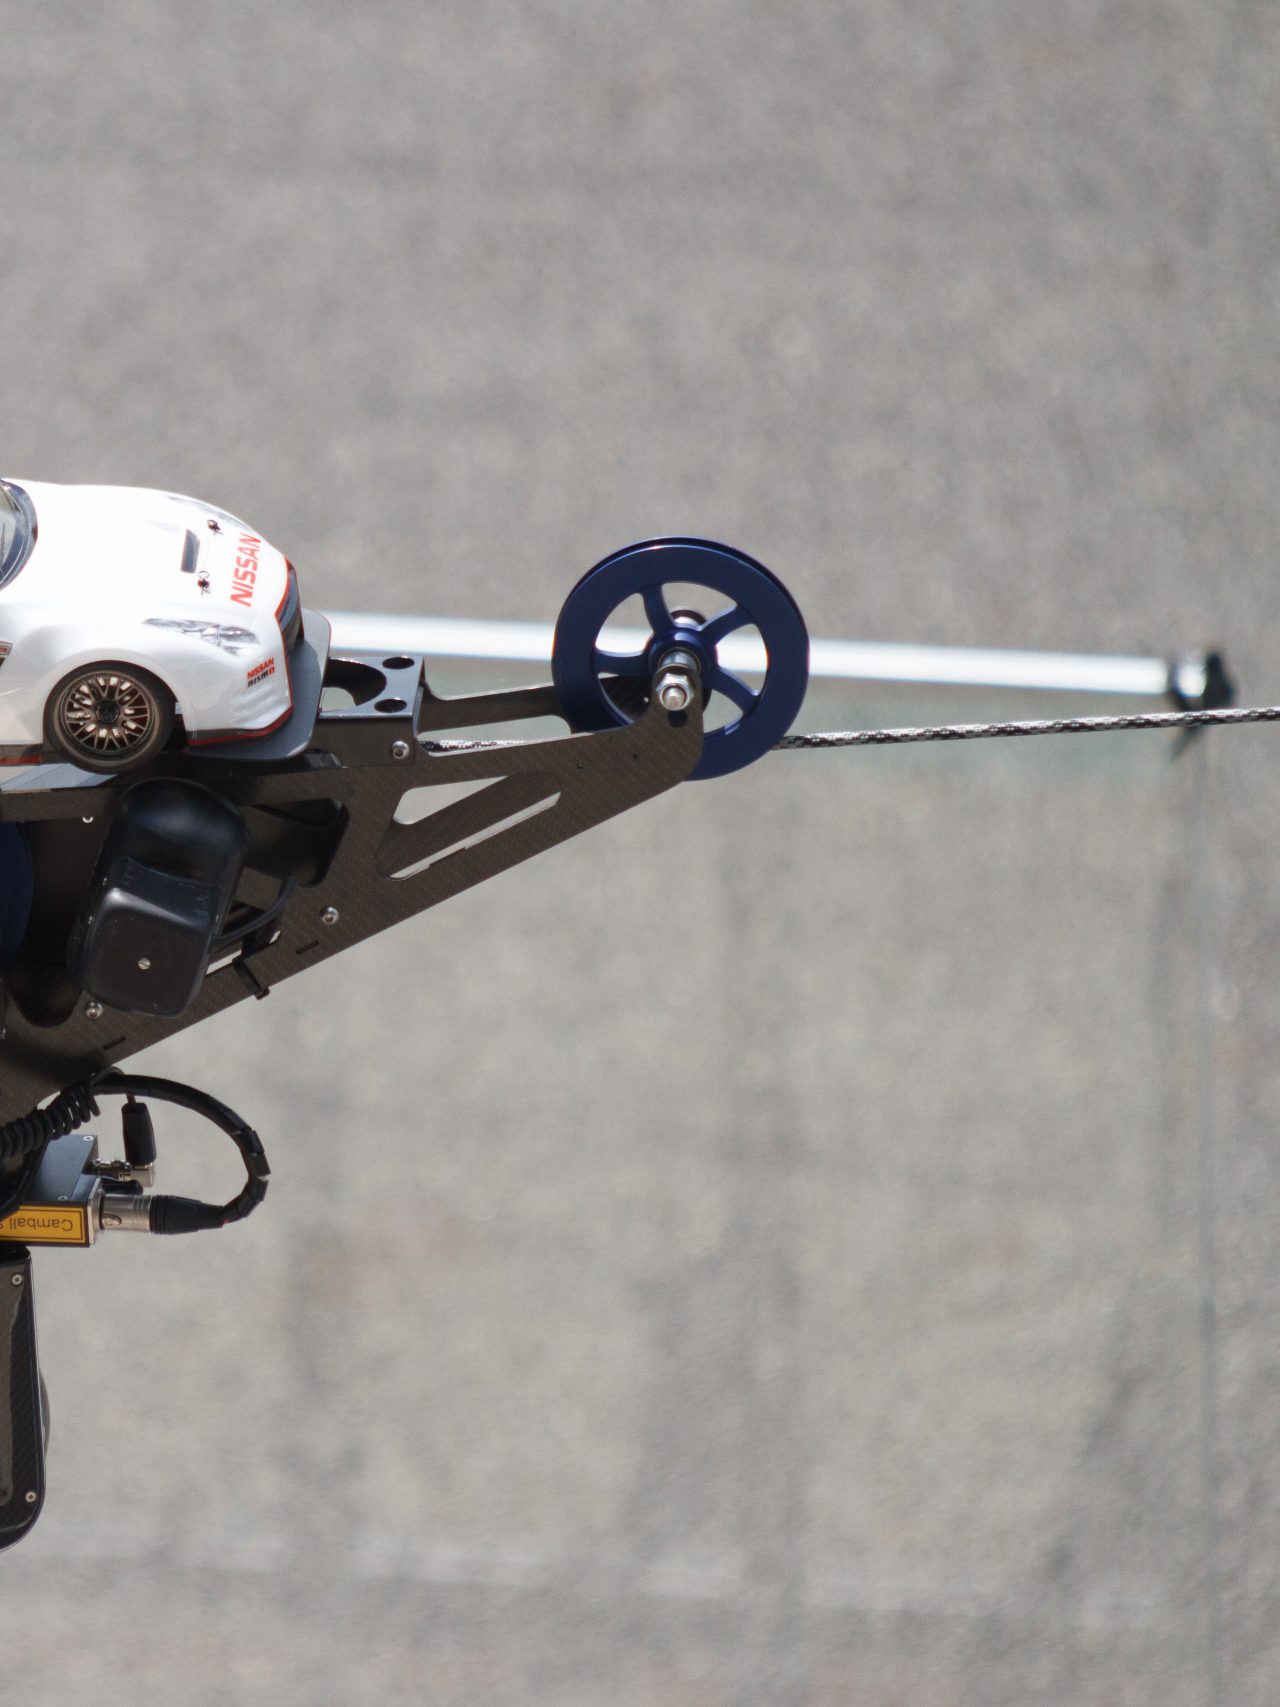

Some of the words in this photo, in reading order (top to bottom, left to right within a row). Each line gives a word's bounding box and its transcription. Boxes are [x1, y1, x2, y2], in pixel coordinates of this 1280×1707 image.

[230, 532, 261, 607] NISSAN
[247, 657, 275, 680] NISSAN
[248, 666, 275, 688] nismo
[9, 1217, 73, 1232] Camball
